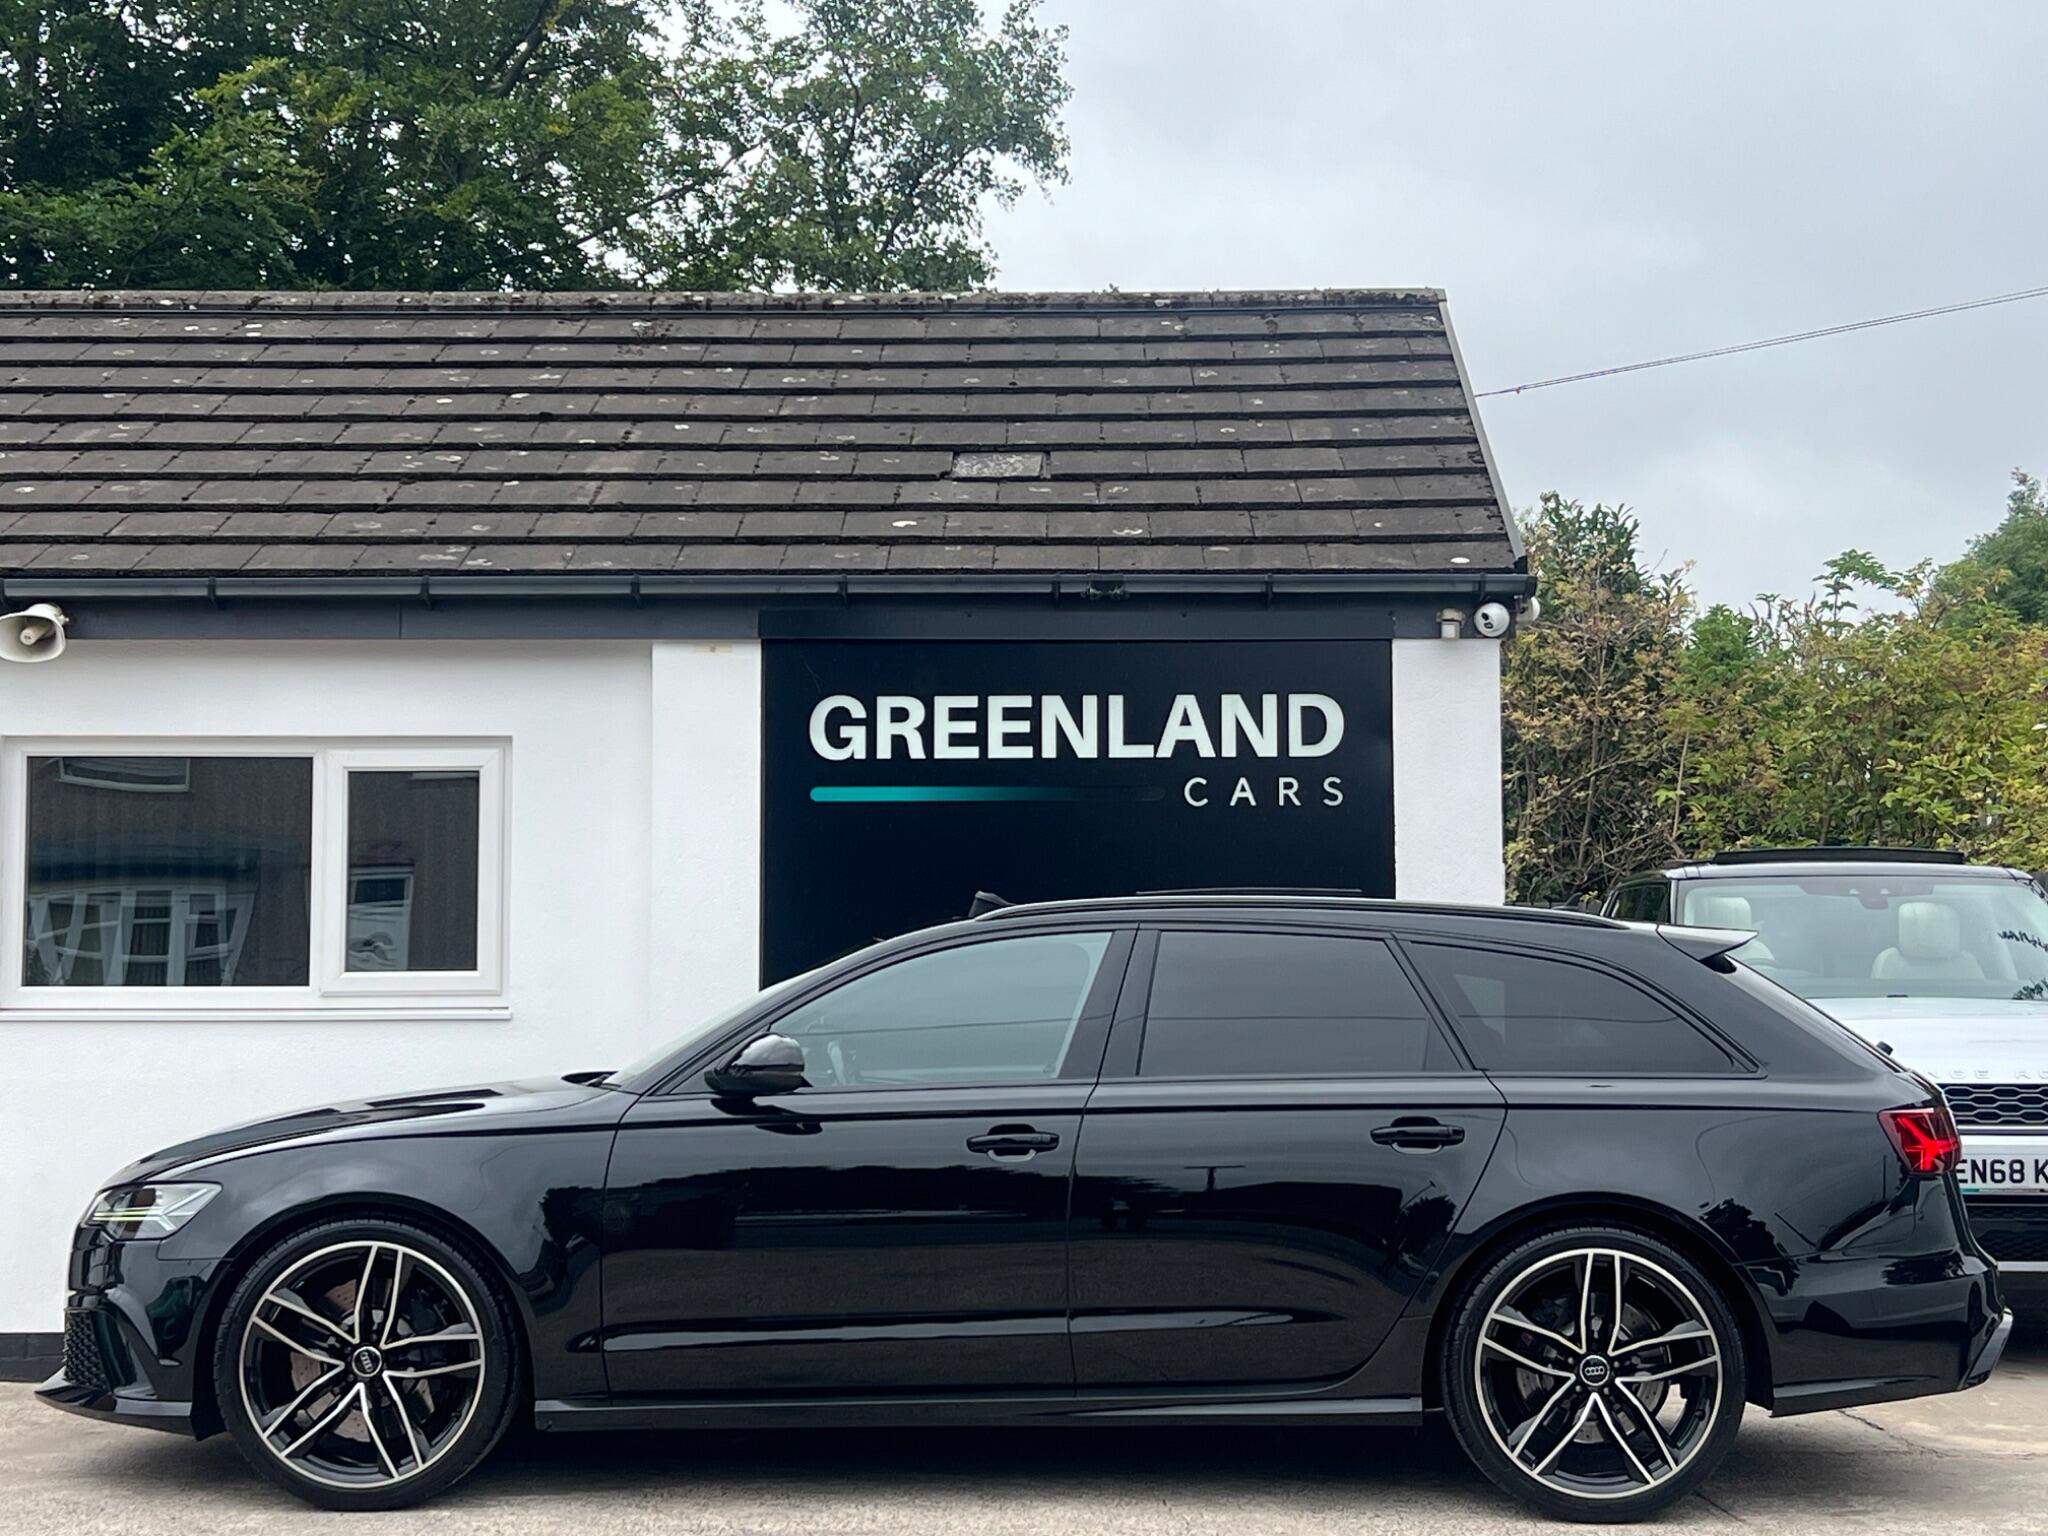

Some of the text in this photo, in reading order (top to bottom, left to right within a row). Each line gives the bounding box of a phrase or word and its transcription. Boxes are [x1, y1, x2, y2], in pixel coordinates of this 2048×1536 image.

[809, 693, 1345, 761] GREENLAND
[1183, 776, 1344, 807] CARS
[1955, 1159, 2025, 1184] EN68
